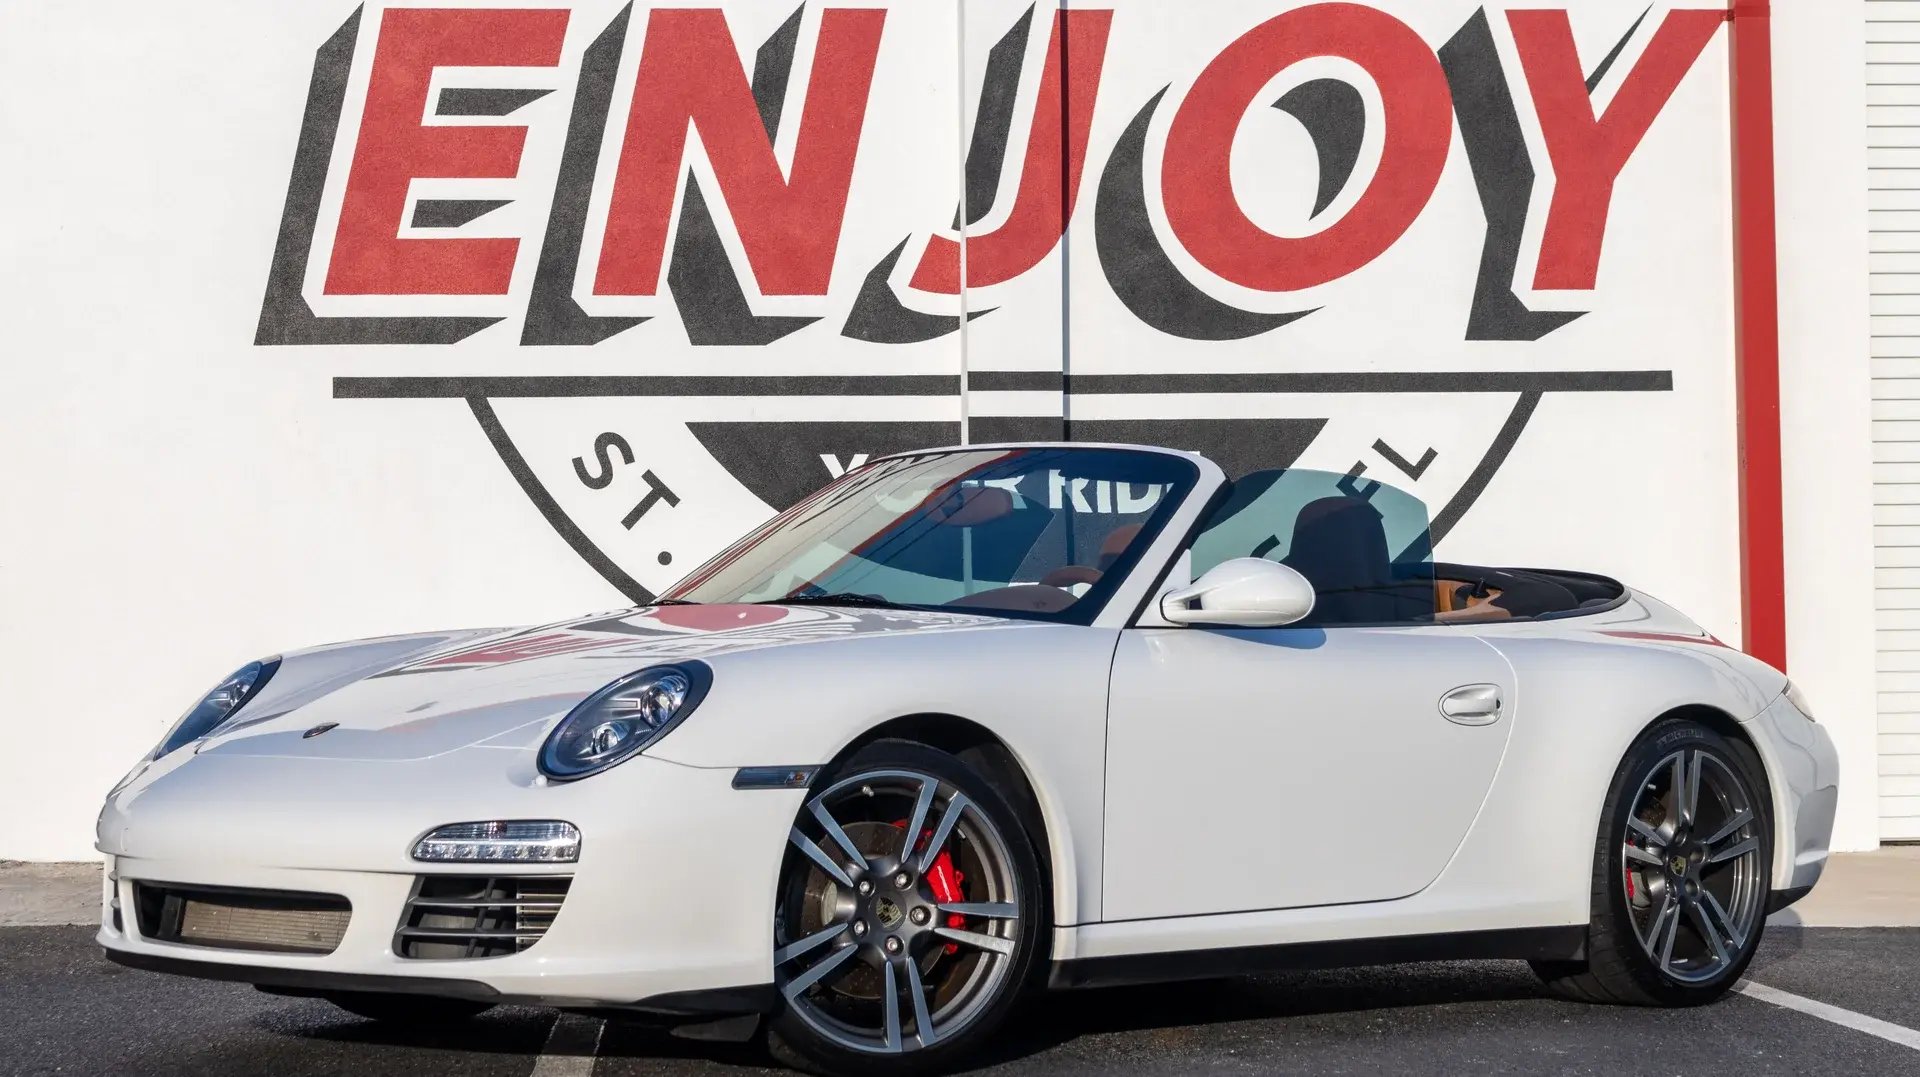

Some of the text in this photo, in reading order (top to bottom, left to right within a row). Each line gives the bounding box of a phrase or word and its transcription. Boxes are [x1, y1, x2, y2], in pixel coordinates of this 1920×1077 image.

[323, 2, 1727, 295] ENJOY
[571, 431, 681, 566] ST.
[1049, 469, 1174, 514] RID
